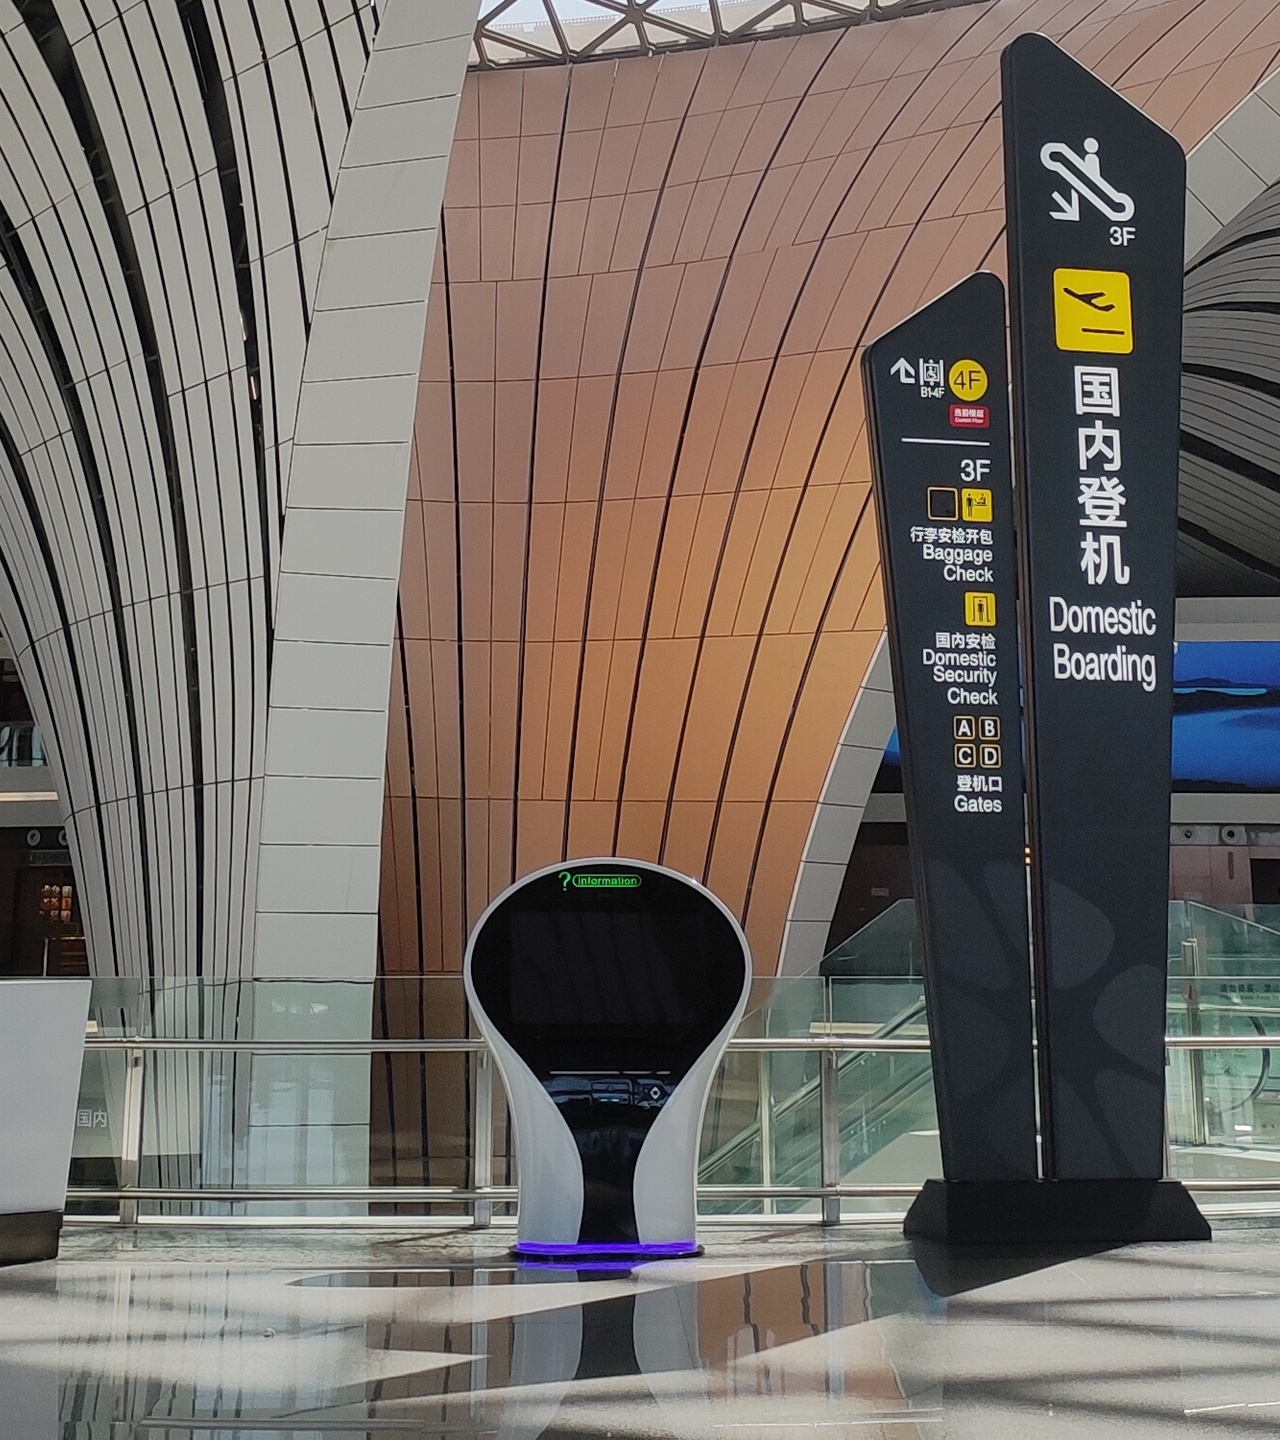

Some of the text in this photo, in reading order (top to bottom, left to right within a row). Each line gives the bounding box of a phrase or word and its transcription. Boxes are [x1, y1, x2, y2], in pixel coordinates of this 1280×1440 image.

[1109, 226, 1136, 246] 3F
[953, 370, 981, 390] 4F
[960, 459, 991, 482] 3F
[1073, 365, 1130, 586] 国内登机
[910, 526, 993, 545] 行李安检开包
[923, 544, 993, 565] Baggage
[943, 565, 994, 582] Check
[1049, 596, 1157, 636] Domestic
[935, 632, 996, 649] 国内安检
[923, 649, 996, 667] Domestic
[1054, 643, 1157, 692] Boarding
[933, 666, 998, 687] Security
[947, 687, 999, 705] Check
[958, 720, 995, 736] A B
[959, 748, 997, 764] C D
[957, 775, 1002, 792] 登机口
[954, 795, 1002, 812] Gates
